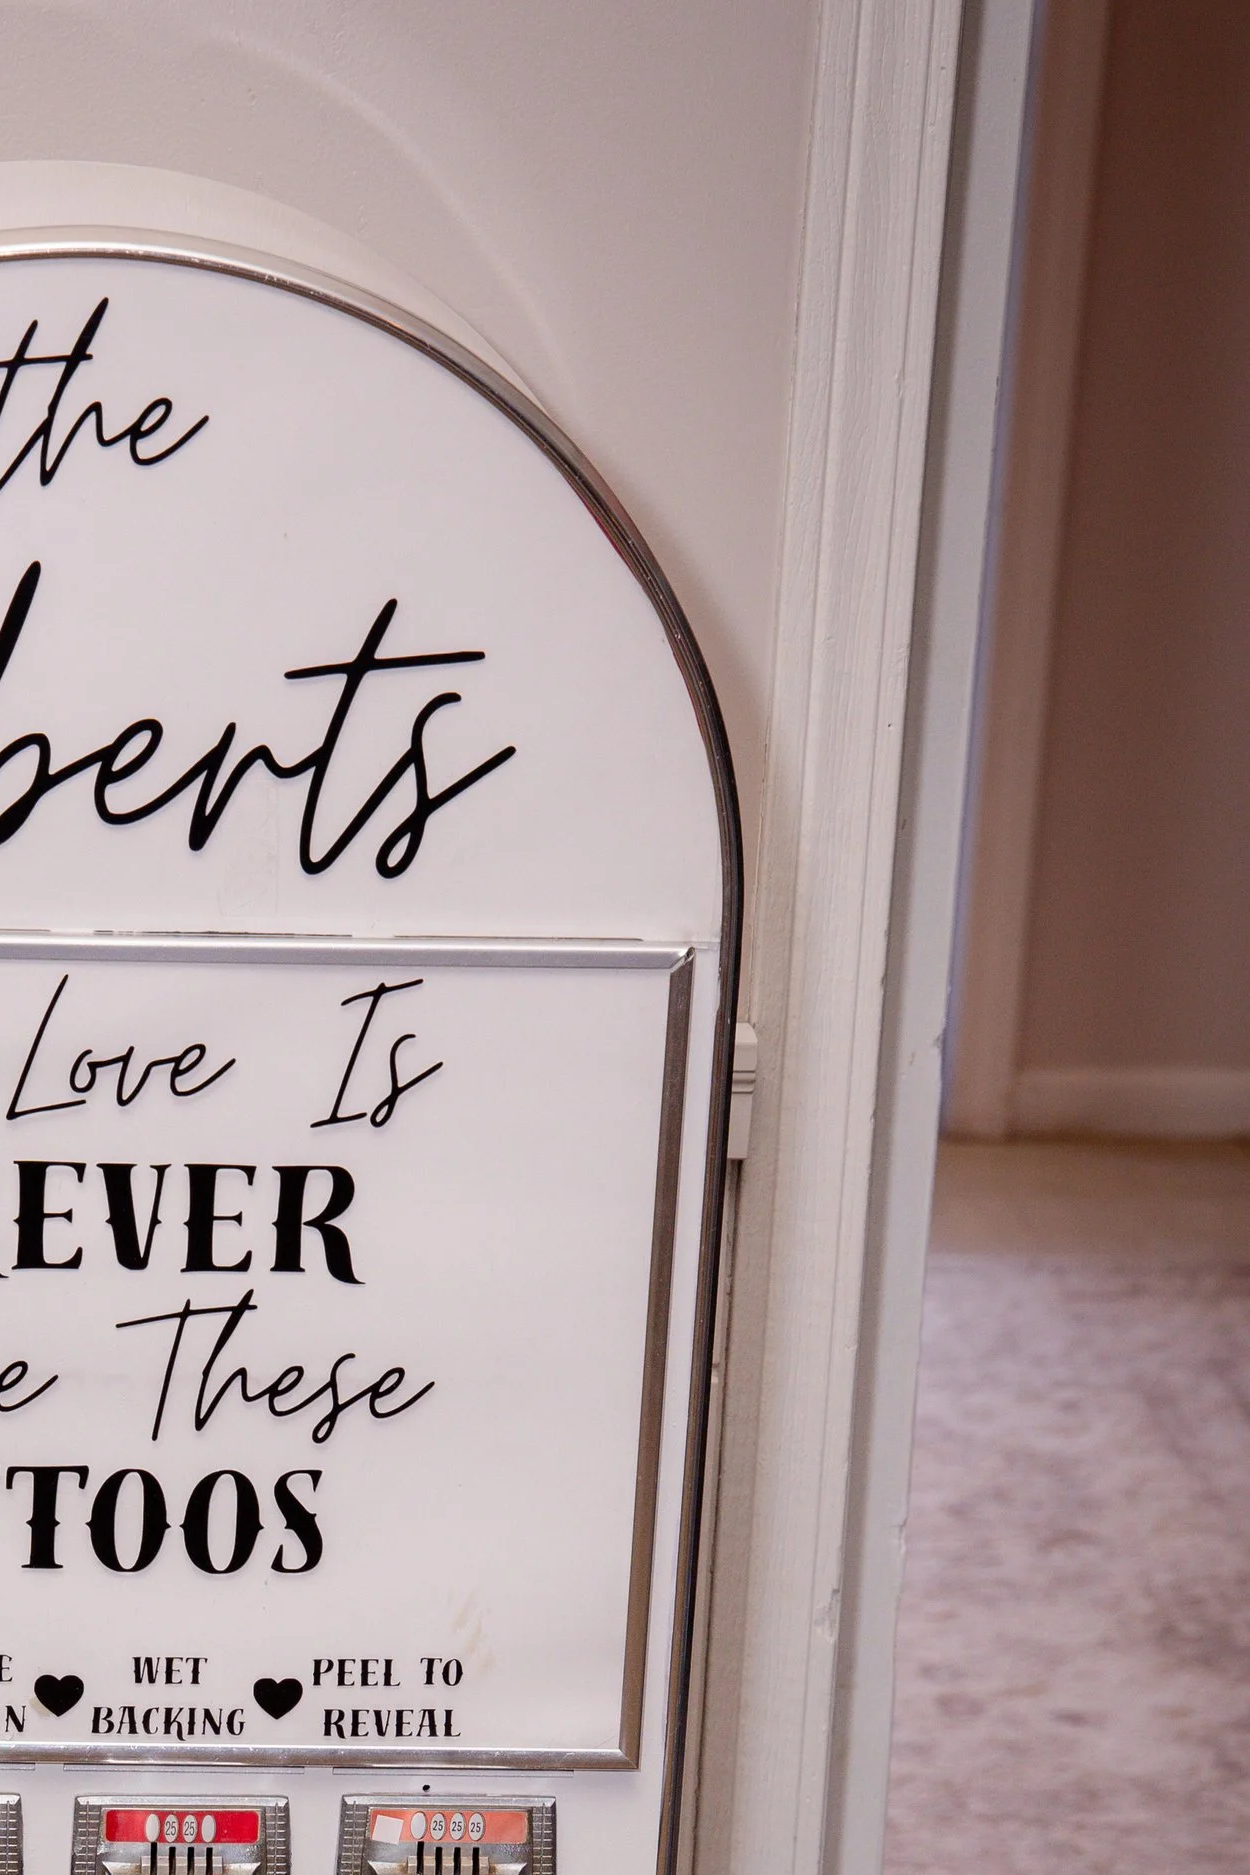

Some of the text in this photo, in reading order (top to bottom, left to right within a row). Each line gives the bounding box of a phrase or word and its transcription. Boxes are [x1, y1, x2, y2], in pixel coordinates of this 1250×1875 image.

[5, 974, 237, 1121] Love
[310, 978, 444, 1129] Is
[115, 1288, 436, 1444] These
[132, 1656, 209, 1686] WET
[311, 1657, 465, 1687] PEEL TO
[91, 1706, 247, 1743] BACKING
[322, 1708, 463, 1740] REVEAL
[165, 1821, 195, 1836] 25 25
[432, 1820, 481, 1833] 25 25 25
